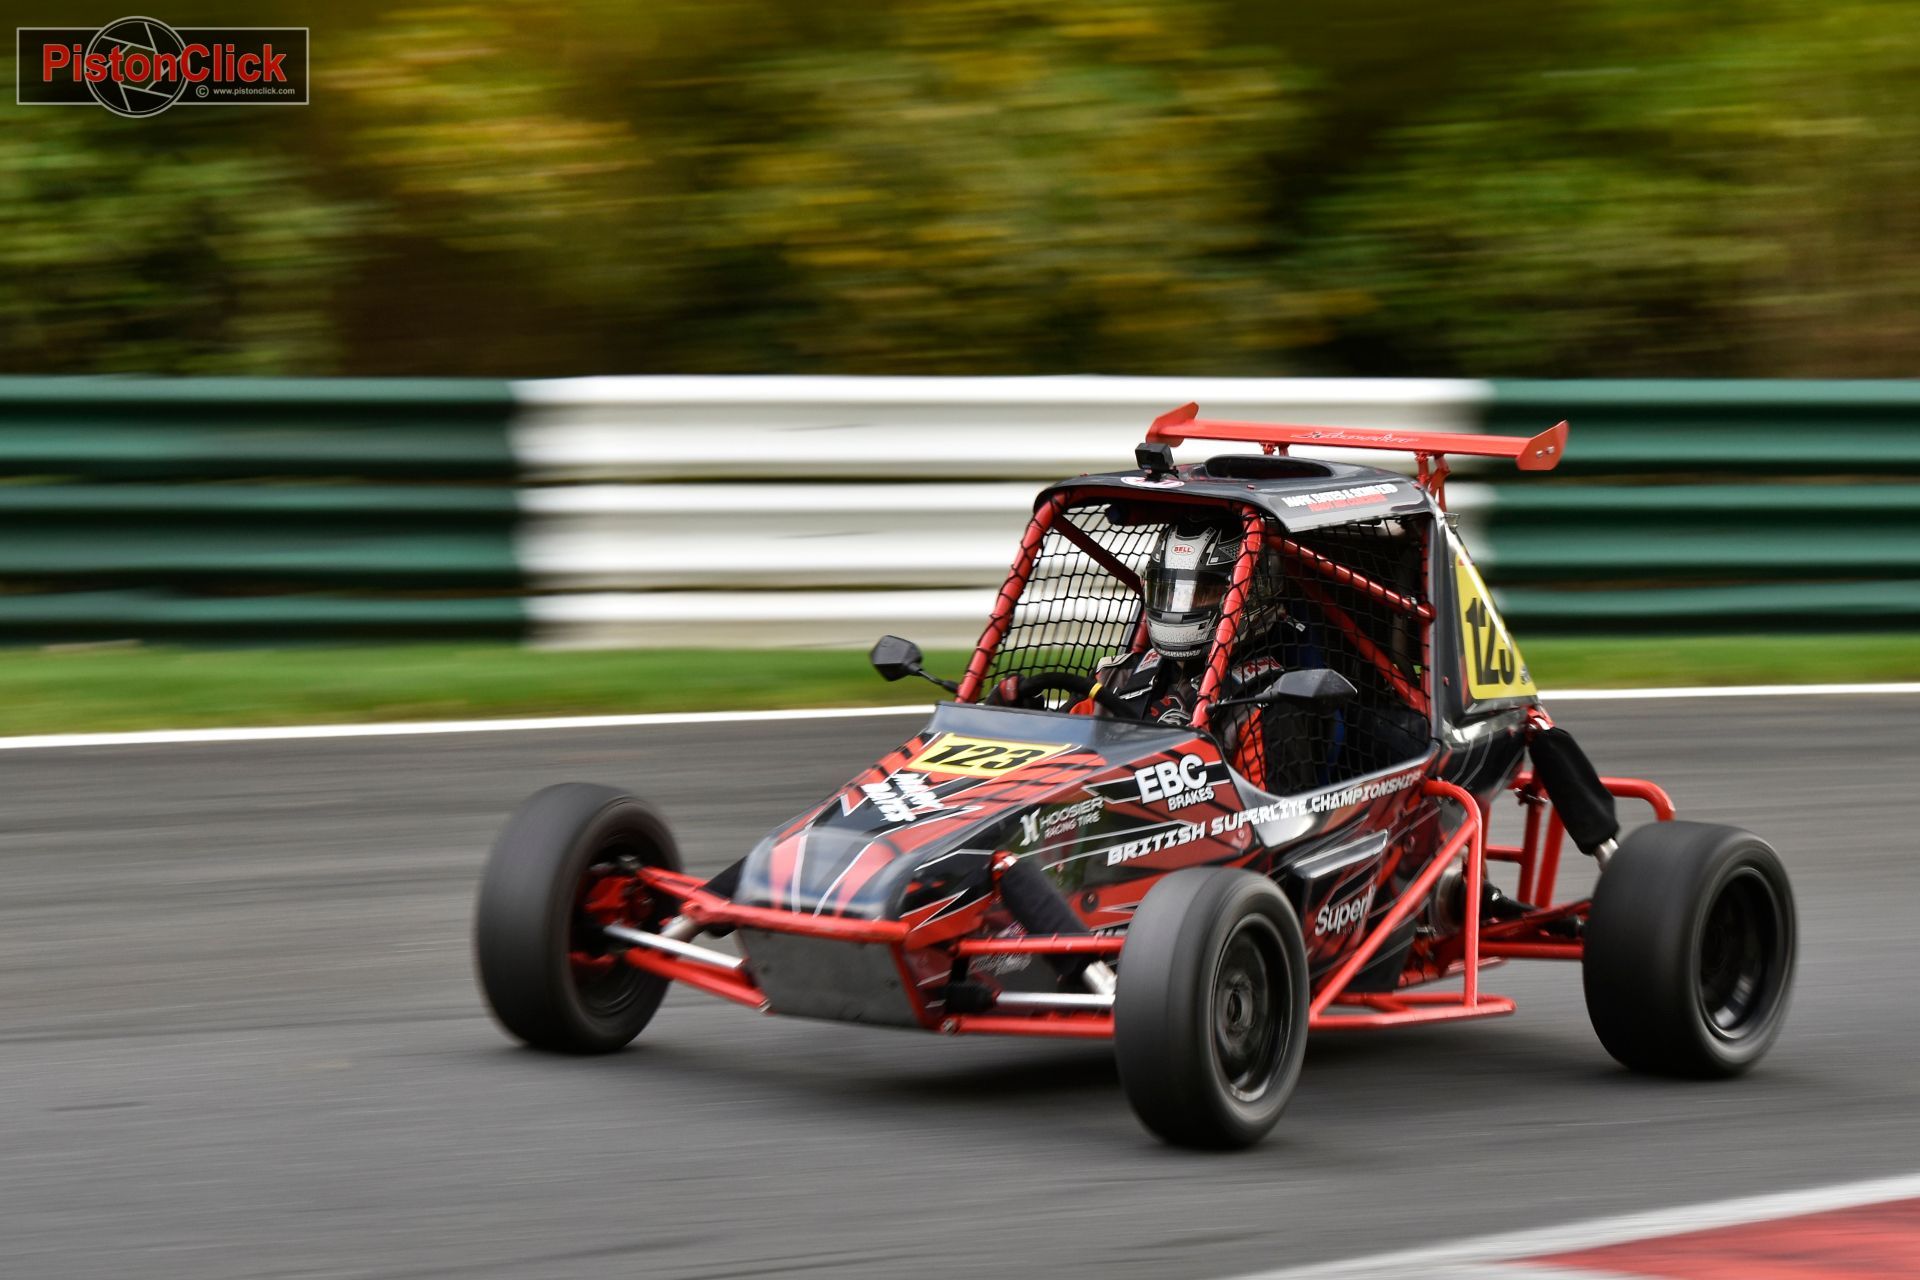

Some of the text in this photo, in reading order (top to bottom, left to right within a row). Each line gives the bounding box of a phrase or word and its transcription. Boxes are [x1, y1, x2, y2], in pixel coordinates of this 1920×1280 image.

[1174, 544, 1192, 553] BELL
[923, 744, 1046, 771] 123
[1134, 753, 1208, 805] EBC
[1039, 795, 1105, 829] HOOSIER
[1168, 786, 1215, 812] BRAKES
[1044, 812, 1102, 840] RACING TIRE
[1106, 821, 1206, 867] BRITISH
[1211, 798, 1309, 836] SUPERLITE
